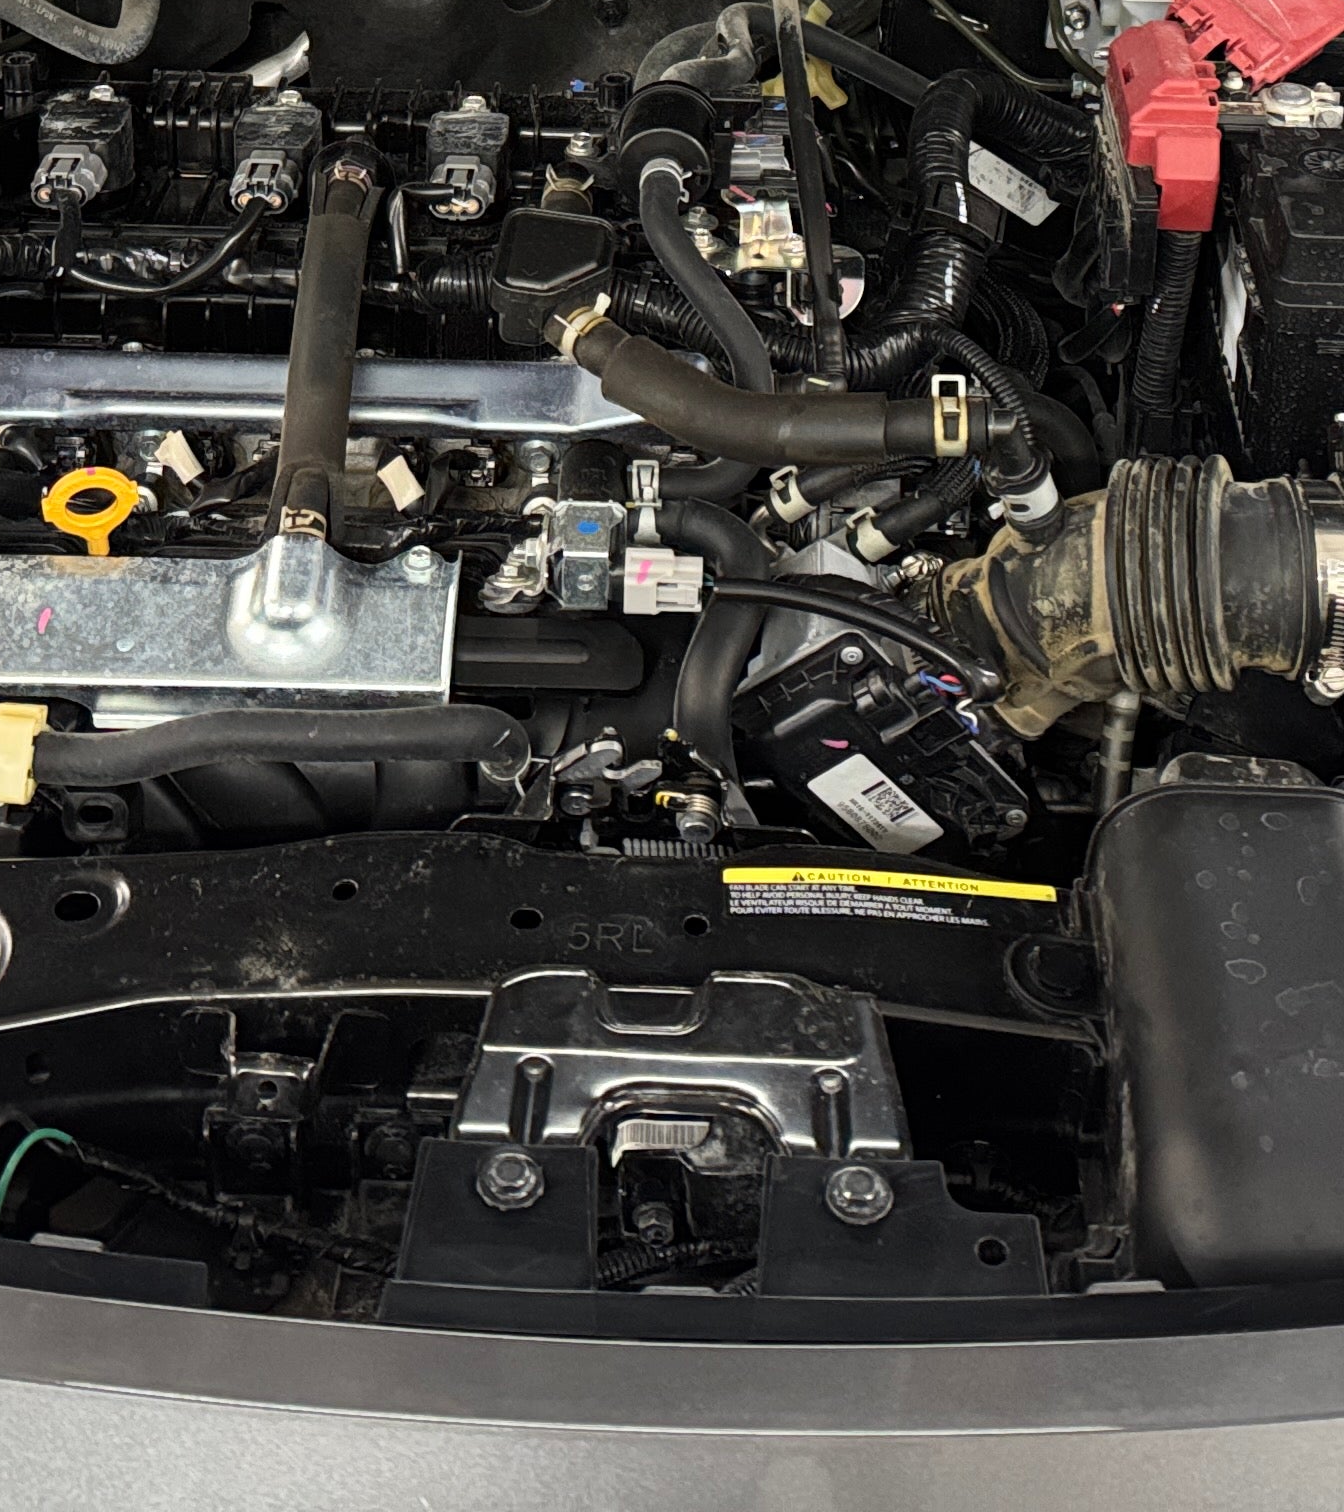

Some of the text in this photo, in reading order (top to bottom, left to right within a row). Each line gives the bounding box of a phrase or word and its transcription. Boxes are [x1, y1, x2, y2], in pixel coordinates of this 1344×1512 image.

[807, 872, 871, 883] CAUTION
[902, 877, 979, 892] ATTENTION
[730, 891, 741, 899] TO
